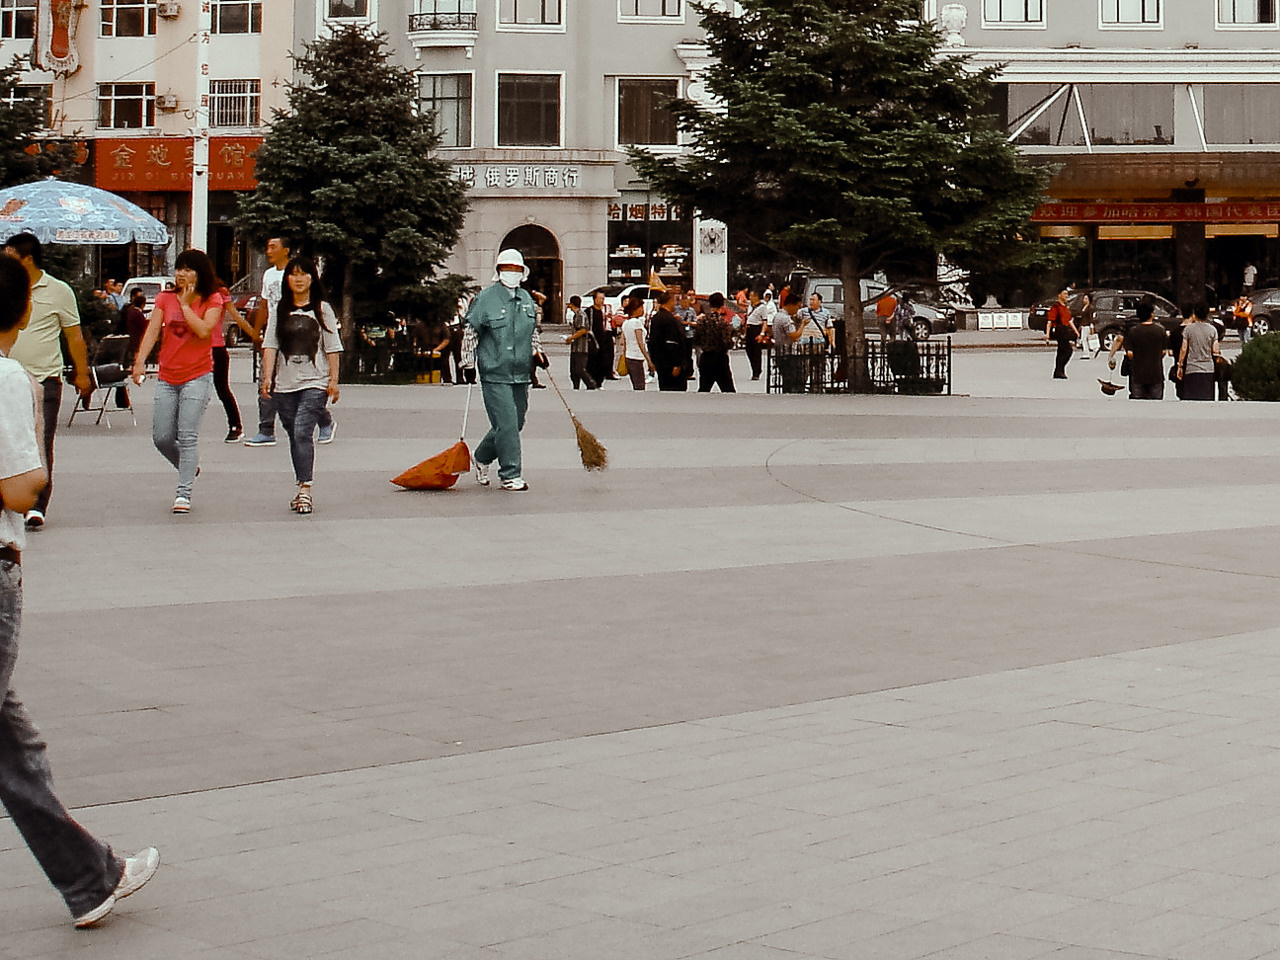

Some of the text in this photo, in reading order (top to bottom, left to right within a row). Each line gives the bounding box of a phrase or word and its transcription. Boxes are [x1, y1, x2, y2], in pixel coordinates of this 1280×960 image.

[485, 167, 578, 187] 俄罗斯商行
